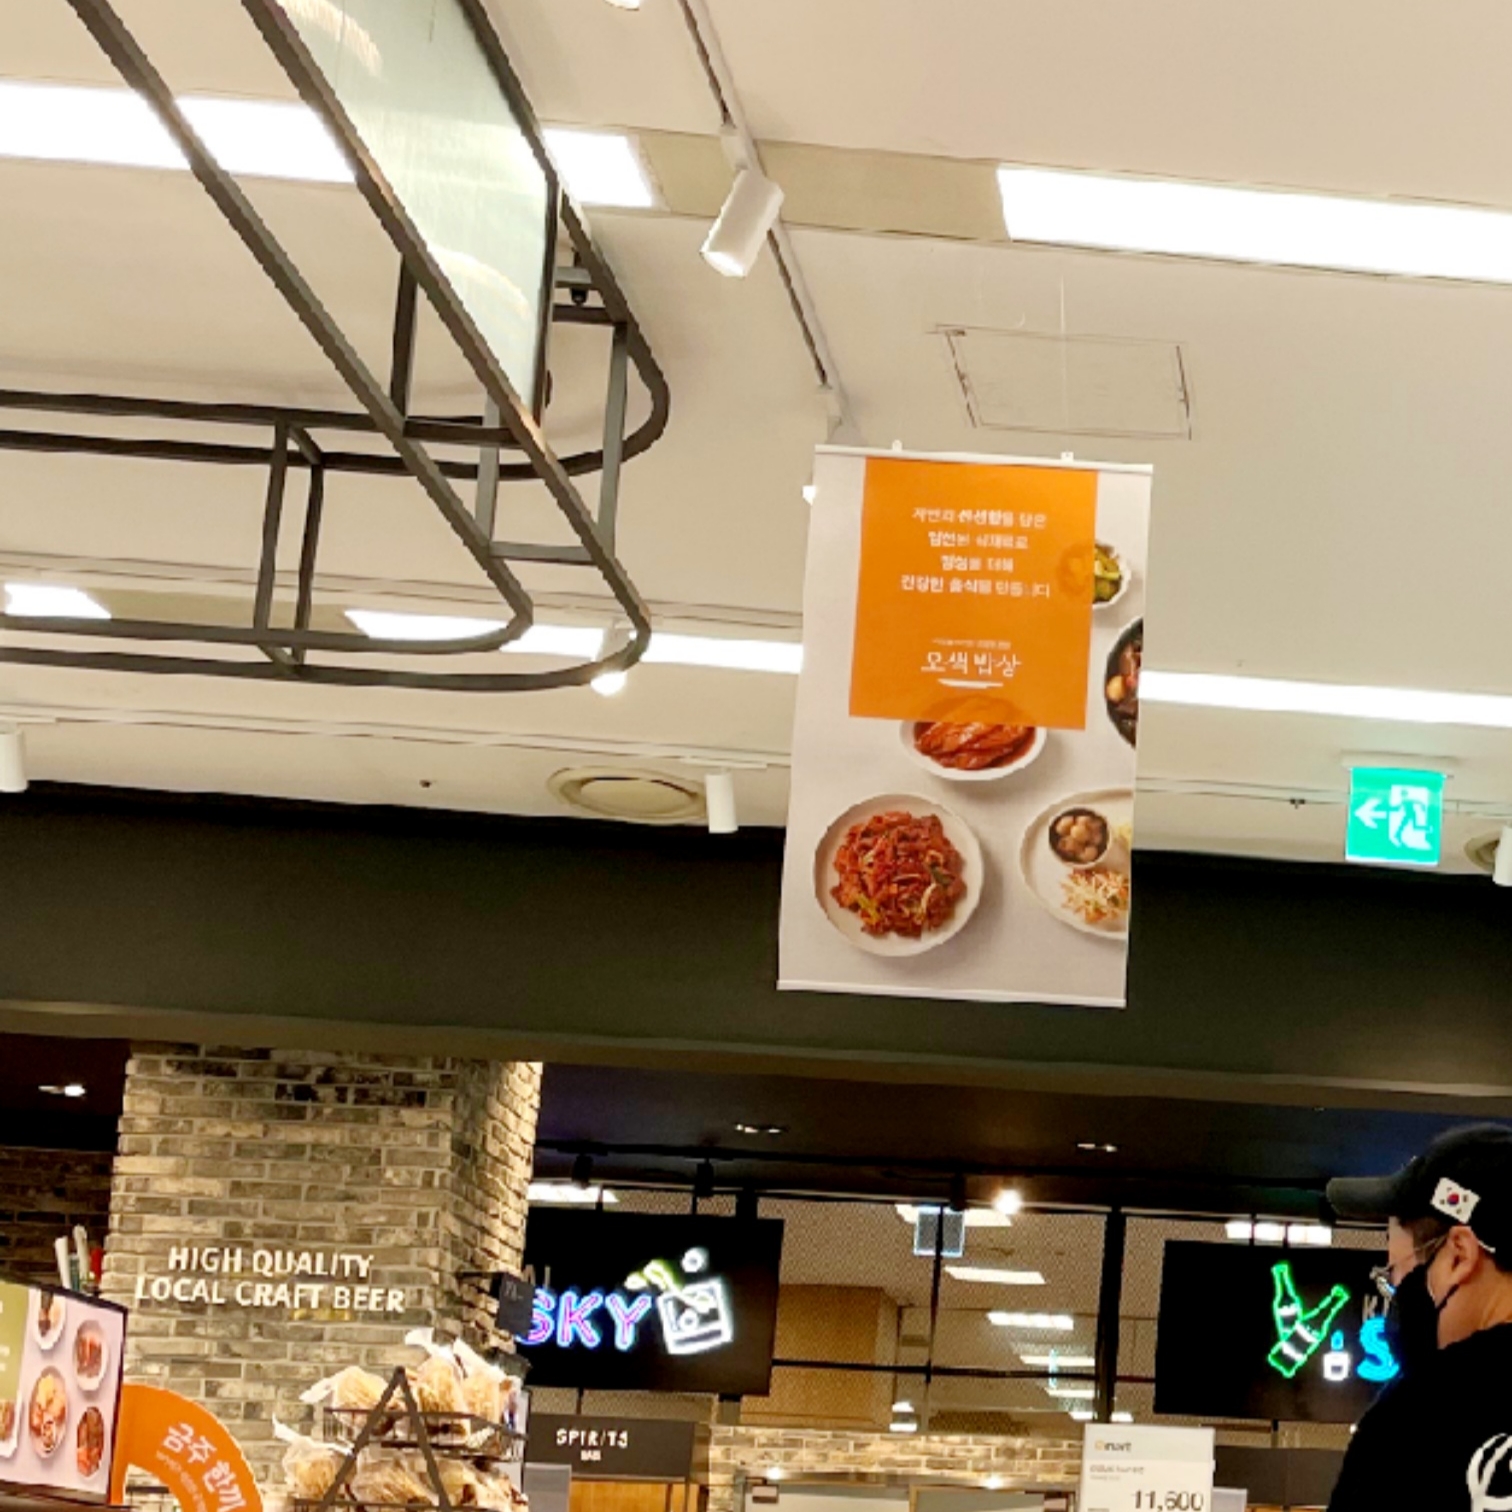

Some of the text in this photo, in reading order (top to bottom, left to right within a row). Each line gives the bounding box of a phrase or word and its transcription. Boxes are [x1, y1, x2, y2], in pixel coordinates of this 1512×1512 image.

[168, 1246, 374, 1278] HIGH QUALITY
[135, 1275, 405, 1313] LOCAL CRAFT BEER
[556, 1428, 629, 1448] SPIRITS
